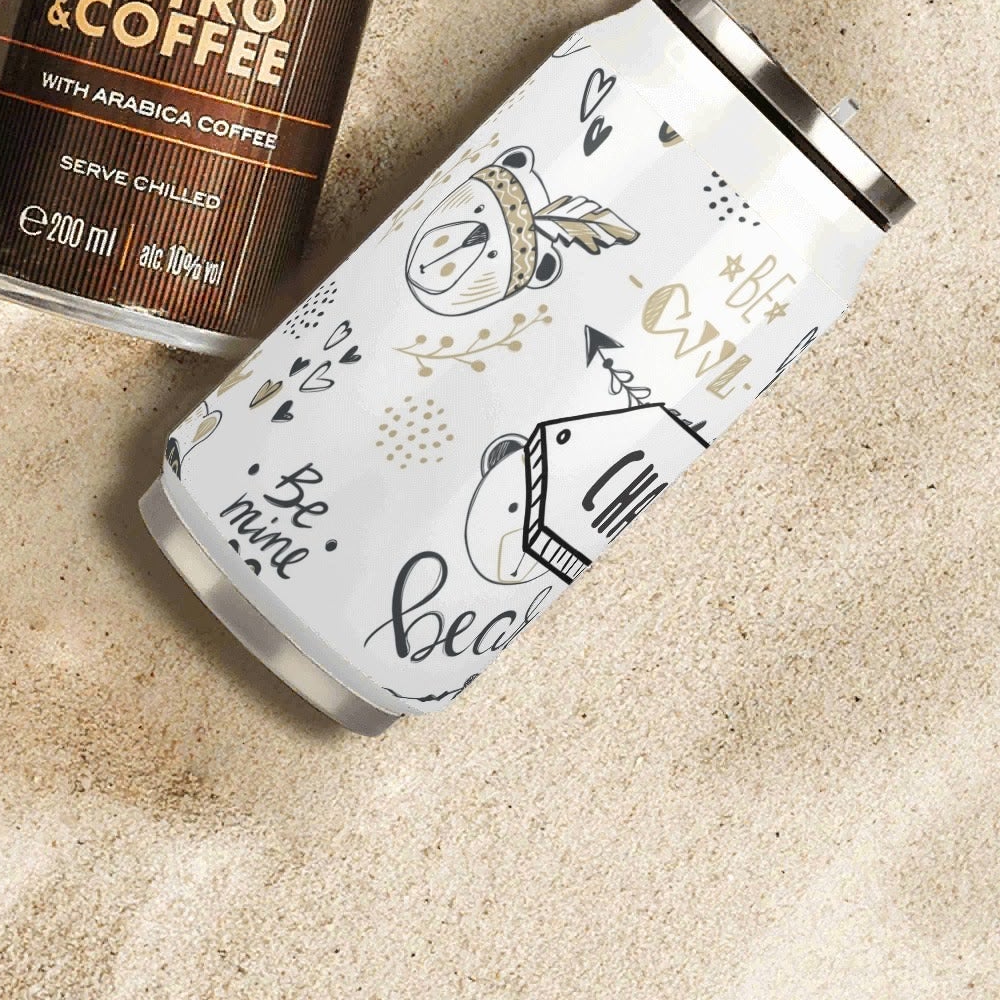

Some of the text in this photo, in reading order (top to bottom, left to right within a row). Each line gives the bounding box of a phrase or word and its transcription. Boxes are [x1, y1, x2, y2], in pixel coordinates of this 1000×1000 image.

[42, 71, 278, 150] WITH ARABICA COFFEE
[59, 155, 221, 210] SERVE CHILLED
[85, 225, 118, 257] ml
[166, 244, 200, 281] 10%
[203, 259, 225, 286] vol
[725, 254, 797, 324] BE
[263, 462, 329, 528] Be
[219, 492, 309, 579] mine
